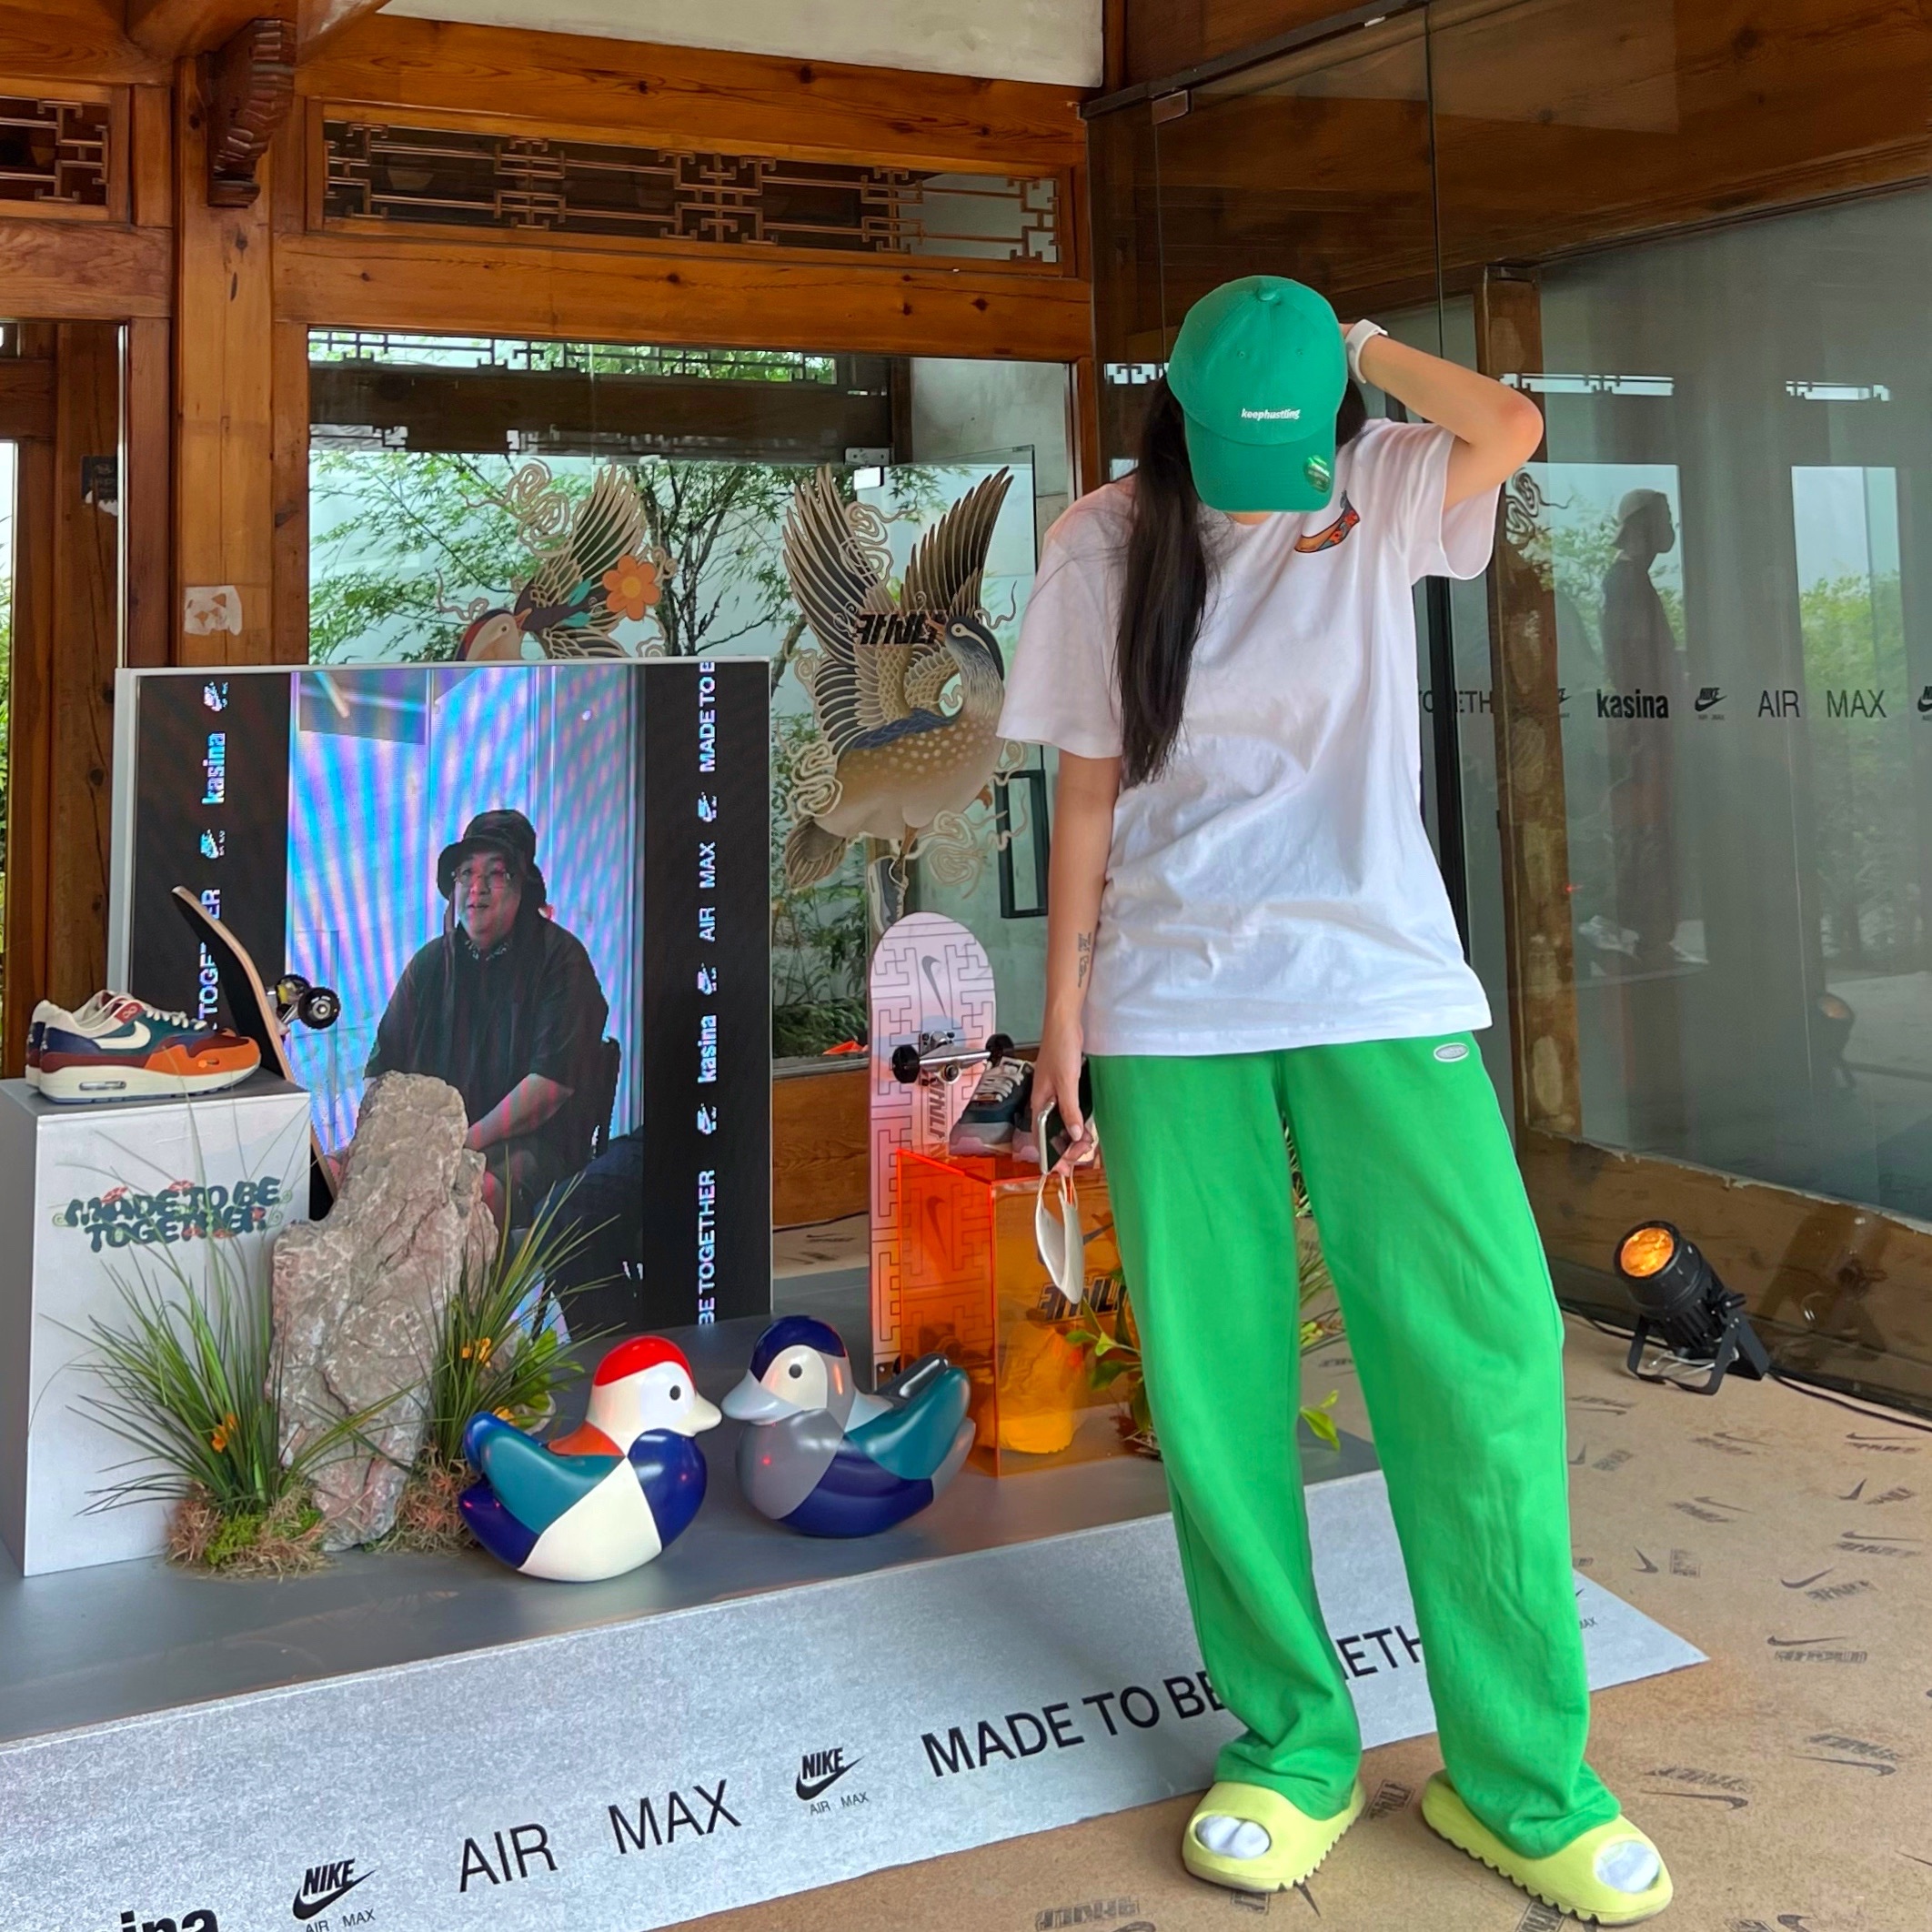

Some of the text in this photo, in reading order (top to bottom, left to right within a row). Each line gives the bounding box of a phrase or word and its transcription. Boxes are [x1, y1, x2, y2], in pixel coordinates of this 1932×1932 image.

[699, 676, 716, 707] TO
[1596, 689, 1669, 719] kasina
[1757, 689, 1887, 719] AIR MAX
[699, 709, 716, 772] MADE
[201, 732, 226, 804] kasina
[699, 841, 716, 889] MAX
[699, 907, 716, 942] AIR
[697, 1014, 717, 1083] kasina
[698, 1169, 716, 1294] TOGETHER
[920, 1701, 1086, 1778] MADE
[1081, 1685, 1161, 1736] TO
[801, 1746, 844, 1780] NIKE
[810, 1791, 870, 1816] AIR MAX
[459, 1778, 742, 1894] AIR MAX
[301, 1857, 356, 1897] NIKE
[342, 1908, 376, 1928] MAX
